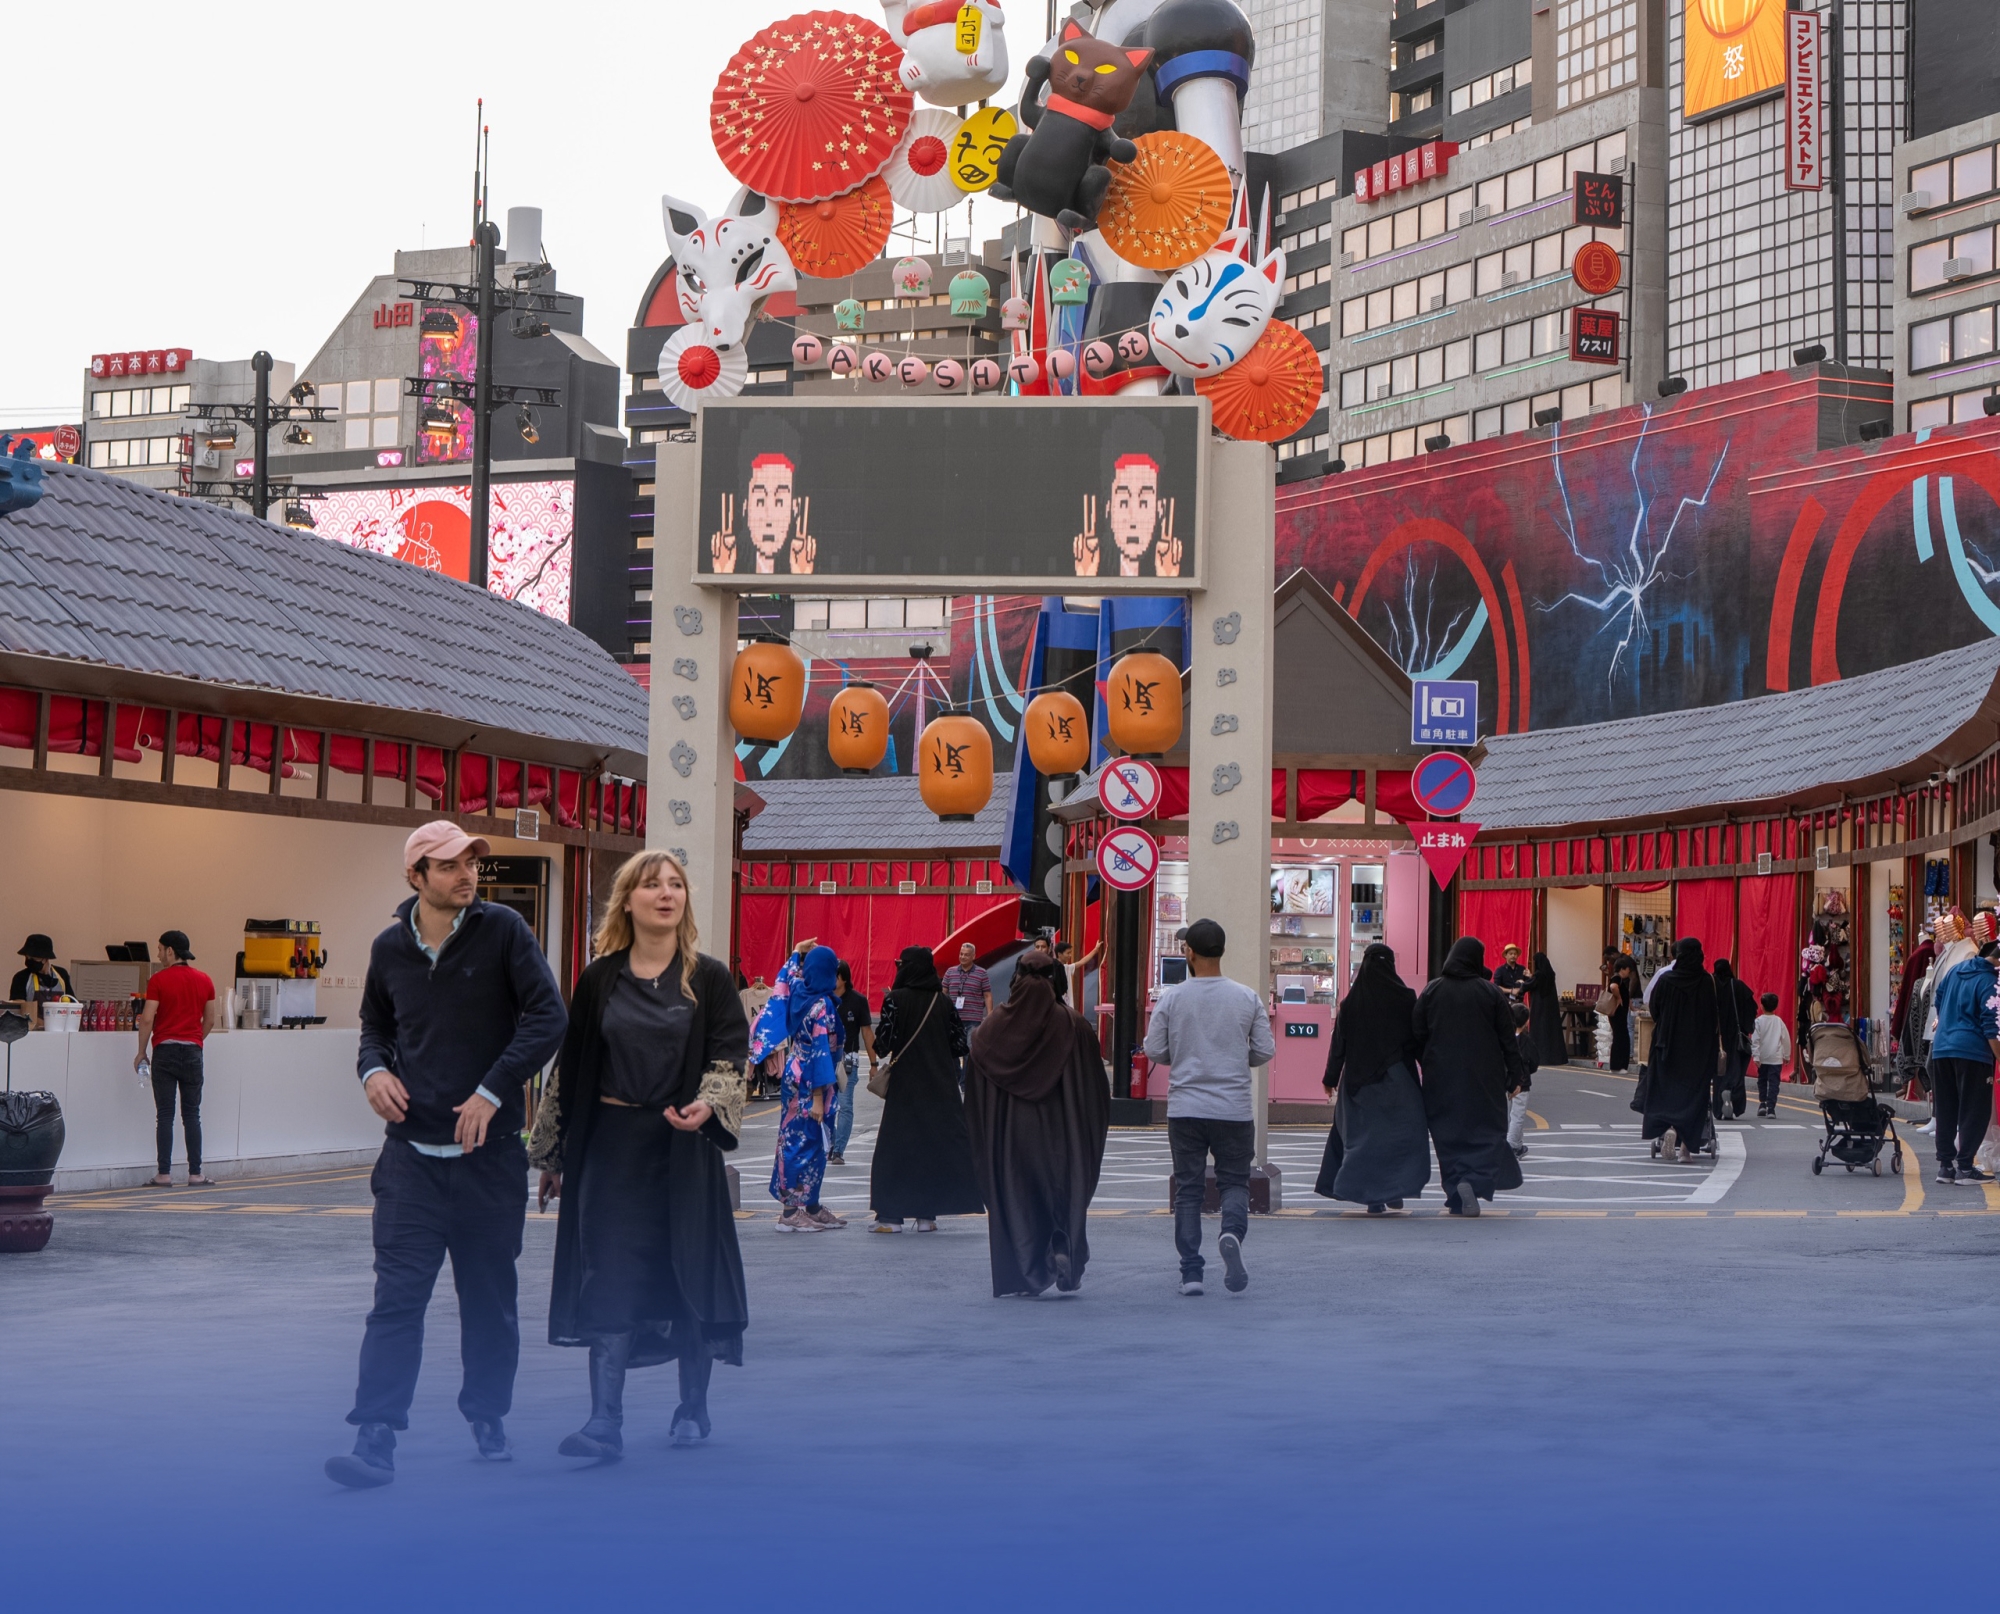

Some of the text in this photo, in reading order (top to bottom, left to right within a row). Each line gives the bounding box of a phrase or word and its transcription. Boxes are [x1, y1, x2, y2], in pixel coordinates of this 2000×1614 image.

[1723, 44, 1745, 80] 怒
[1584, 181, 1615, 199] どん
[1585, 200, 1615, 218] ぶり
[373, 302, 413, 329] 山田
[1580, 317, 1613, 337] 薬屋
[1580, 338, 1612, 354] クスリ
[110, 354, 159, 371] 六本木
[60, 431, 75, 440] アート
[60, 441, 75, 450] ホテル
[1420, 728, 1469, 740] 直角駐車
[1420, 832, 1466, 848] 止まれ
[1289, 1025, 1314, 1035] SYO
